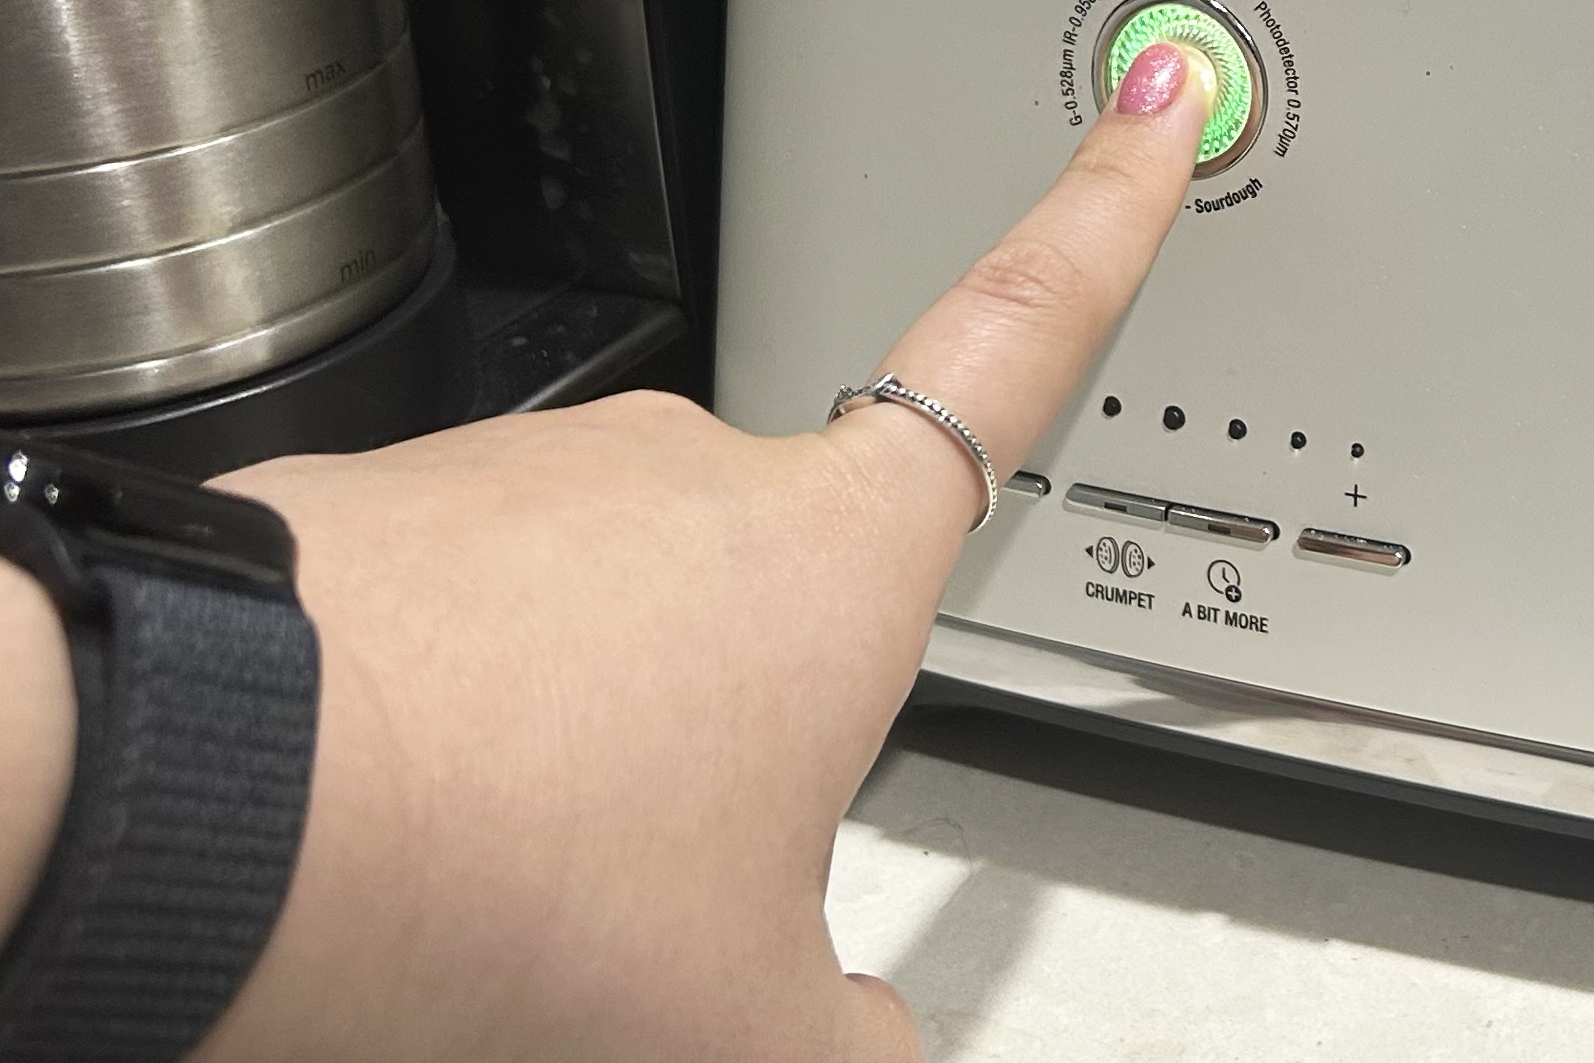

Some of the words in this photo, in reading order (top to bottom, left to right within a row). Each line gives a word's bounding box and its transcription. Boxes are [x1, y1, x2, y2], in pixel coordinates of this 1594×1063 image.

[1254, 1, 1300, 96] Photodetector
[305, 60, 347, 91] max
[1195, 177, 1263, 214] Sourdough
[340, 247, 377, 284] min
[1085, 581, 1155, 610] CRUMPET
[1181, 602, 1194, 619] A
[1197, 604, 1220, 624] BIT
[1224, 609, 1269, 634] MORE
